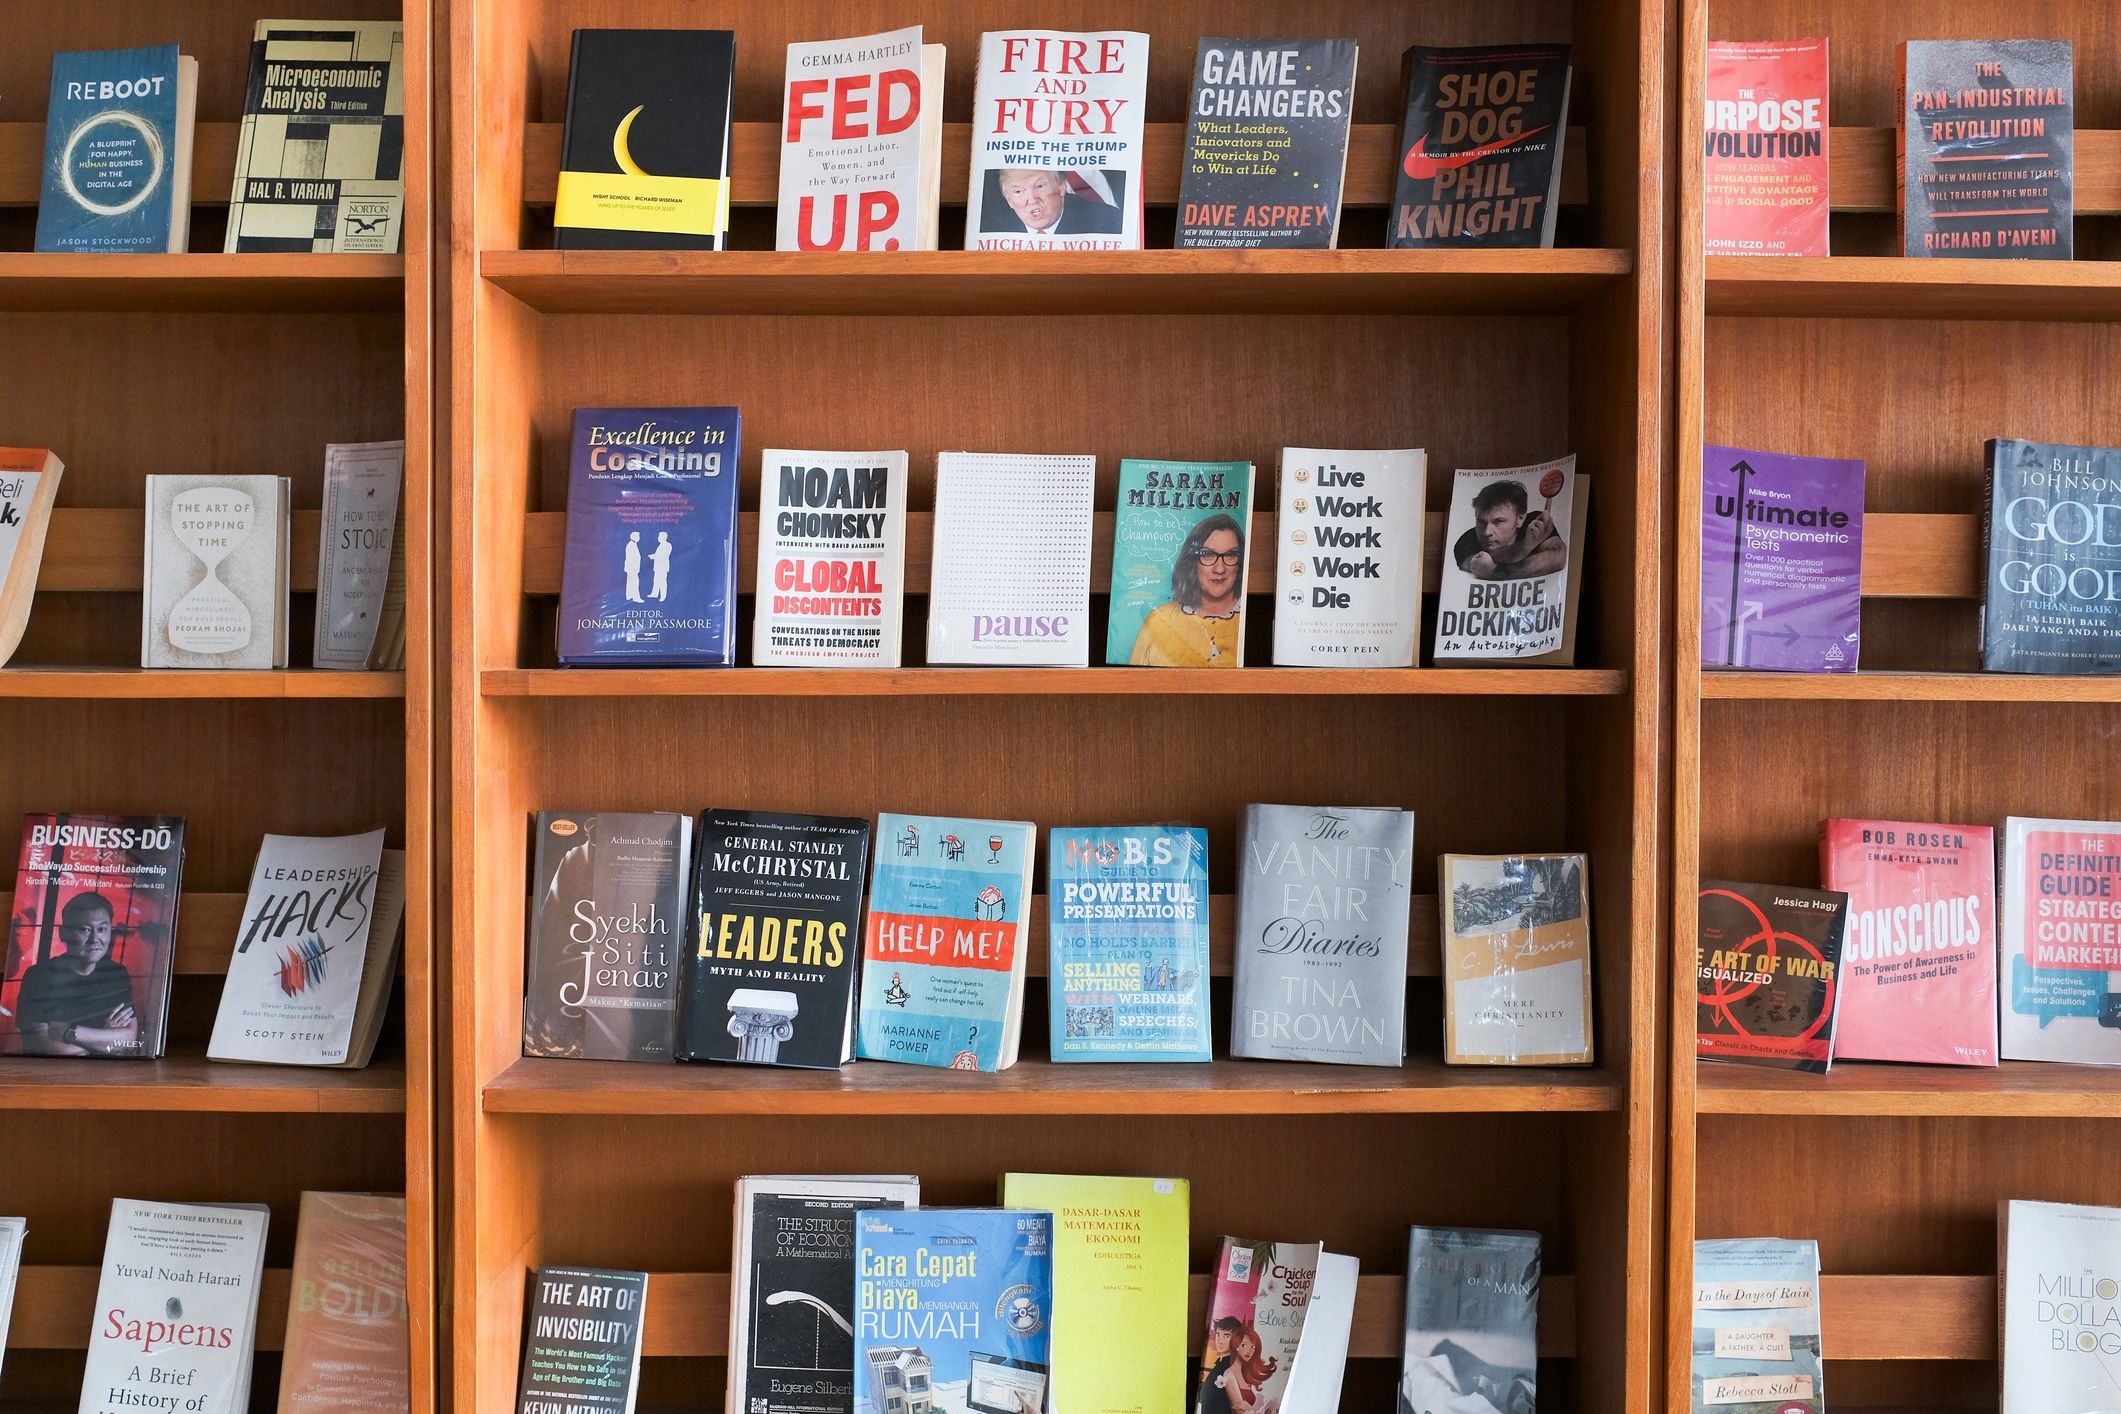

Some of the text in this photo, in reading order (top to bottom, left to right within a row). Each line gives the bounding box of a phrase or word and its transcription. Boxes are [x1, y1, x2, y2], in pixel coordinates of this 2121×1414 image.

[801, 41, 912, 67] GEMMA HARTLEY
[1000, 38, 1125, 74] FIRE
[265, 65, 382, 88] Microeconomic
[1203, 50, 1299, 86] GAME
[67, 76, 165, 100] REBOOT
[1033, 78, 1087, 95] AND
[1435, 70, 1538, 108] SHOE
[262, 87, 326, 110] Analysis
[786, 68, 921, 143] FED
[1197, 89, 1343, 118] CHANGERS
[1913, 88, 2066, 110] PAN-INDUSTRIAL
[992, 99, 1128, 135] FURY
[1441, 106, 1524, 144] DOG
[1932, 118, 2045, 141] REVOLUTION
[986, 141, 1127, 152] INSIDE THE TRUMP
[249, 181, 335, 200] HAL R. VARIAN
[1432, 163, 1515, 200] PHIL
[1737, 196, 1813, 206] SOCIAL GOOD
[1184, 204, 1327, 227] DAVE ASPREY
[1397, 196, 1543, 238] KNIGHT
[57, 237, 152, 246] JASON STOCKWOOD
[1707, 240, 1763, 248] JOHN IZZO
[1924, 229, 2056, 249] RICHARD D'AVENI
[588, 423, 725, 446] Excellence in
[590, 446, 721, 477] Coaching
[2052, 458, 2094, 475] BILL
[778, 466, 888, 508] NOAM
[1146, 471, 1224, 490] SARAH
[1317, 465, 1365, 488] Live
[1127, 489, 1240, 510] MILLICAN
[1749, 488, 1791, 499] Mike Bryon
[177, 504, 250, 512] THE ART OF
[1315, 496, 1383, 517] Work
[182, 521, 244, 529] STOPPING
[777, 513, 886, 538] CHOMSKY
[1746, 525, 1849, 544] Psychometric
[199, 538, 227, 547] TIME
[341, 529, 388, 549] STOIC
[1314, 526, 1381, 548] Work
[1745, 537, 1780, 551] Tests
[2064, 550, 2075, 561] is
[775, 560, 882, 593] GLOBAL
[1312, 556, 1380, 578] Work
[1312, 586, 1350, 609] Die
[1468, 579, 1546, 609] BRUCE
[773, 596, 881, 616] DISCONTENTS
[577, 619, 711, 630] JONATHAN PASSMORE
[972, 614, 1068, 641] pause
[1441, 602, 1562, 637] DICKINSON
[772, 637, 880, 648] THREATS TO DEMOCRACY
[1311, 645, 1349, 653] COREY
[1304, 814, 1349, 841] The
[724, 837, 844, 856] GENERAL STANLEY
[1863, 830, 1963, 848] BOB ROSEN
[74, 862, 167, 875] Successful Leadership
[712, 853, 850, 881] McCHRYSTAL
[1251, 841, 1407, 881] VANITY
[264, 865, 371, 881] LEADERSHIP
[1063, 883, 1195, 903] POWERFUL
[2039, 875, 2110, 897] GUIDE
[238, 871, 379, 953] HACKS
[1063, 906, 1195, 919] PRESENTATIONS
[1282, 884, 1369, 922] FAIR
[1773, 897, 1838, 911] Jessica Hagy
[570, 899, 669, 943] Syekh
[1846, 895, 1980, 962] CONSCIOUS
[698, 912, 847, 968] LEADERS
[878, 919, 1002, 961] HELP ME!
[1257, 917, 1382, 959] Diaries
[602, 938, 668, 965] Siti
[1063, 963, 1141, 978] SELLING
[1711, 951, 1834, 979] ART OF WAR
[559, 951, 668, 1007] Jenar
[1063, 978, 1140, 992] ANYTHING
[1877, 968, 1957, 986] Business and Life
[1279, 976, 1361, 1008] TINA
[245, 1029, 324, 1040] SCOTT STEIN
[881, 1026, 940, 1040] MARIANNE
[1251, 1009, 1385, 1046] BROWN
[889, 1040, 929, 1053] POWER
[1062, 1207, 1141, 1218] DASAR-DASAR
[1064, 1220, 1141, 1231] MATEMATIKA
[1086, 1234, 1141, 1244] EKONOMI
[116, 1264, 241, 1287] Yuval Noah Harari
[861, 1248, 976, 1284] Cara Cepat
[861, 1281, 918, 1310] Biaya
[1285, 1278, 1310, 1291] Soup
[1494, 1281, 1530, 1295] MAN
[1697, 1286, 1810, 1302] In the Days of Rain
[543, 1281, 639, 1311] THE ART OF
[1282, 1293, 1306, 1307] Soul
[104, 1308, 233, 1353] Sapiens
[536, 1316, 633, 1344] INVISIBILITY
[860, 1312, 980, 1339] RUMAH
[128, 1366, 196, 1385] A Brief
[108, 1388, 208, 1411] History of
[1716, 1383, 1799, 1398] Rebecca Stott
